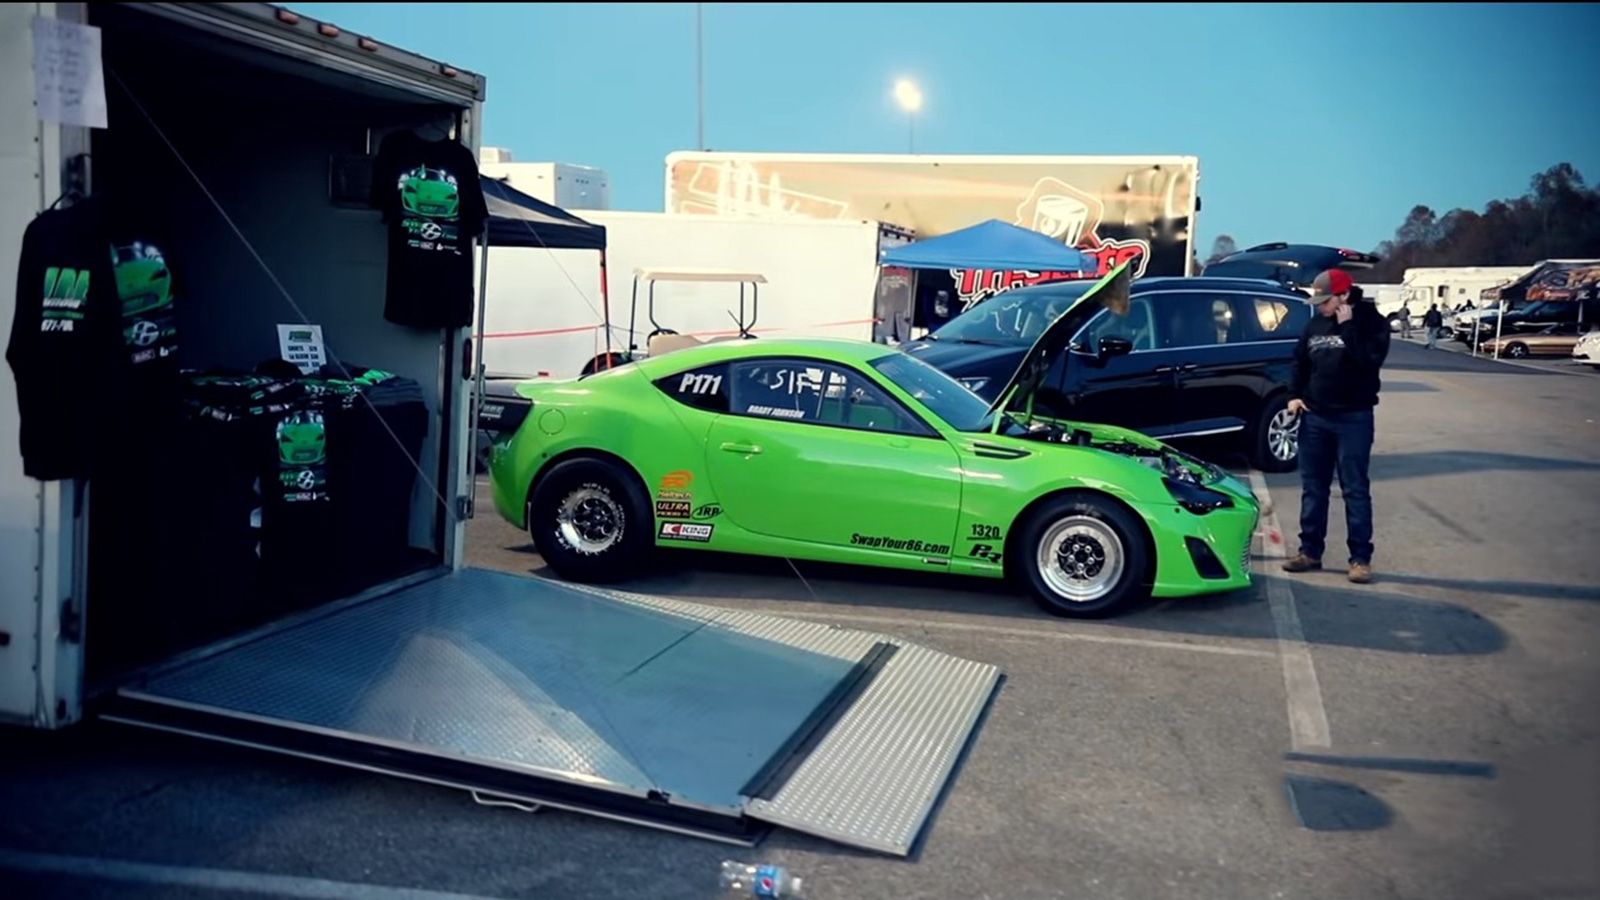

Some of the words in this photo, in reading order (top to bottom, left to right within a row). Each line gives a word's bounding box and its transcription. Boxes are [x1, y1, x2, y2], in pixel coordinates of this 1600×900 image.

[679, 373, 722, 395] P171
[657, 502, 689, 510] ULTRA
[681, 526, 709, 535] KING
[971, 524, 1000, 538] 1320
[850, 533, 950, 555] SwapYour86.com
